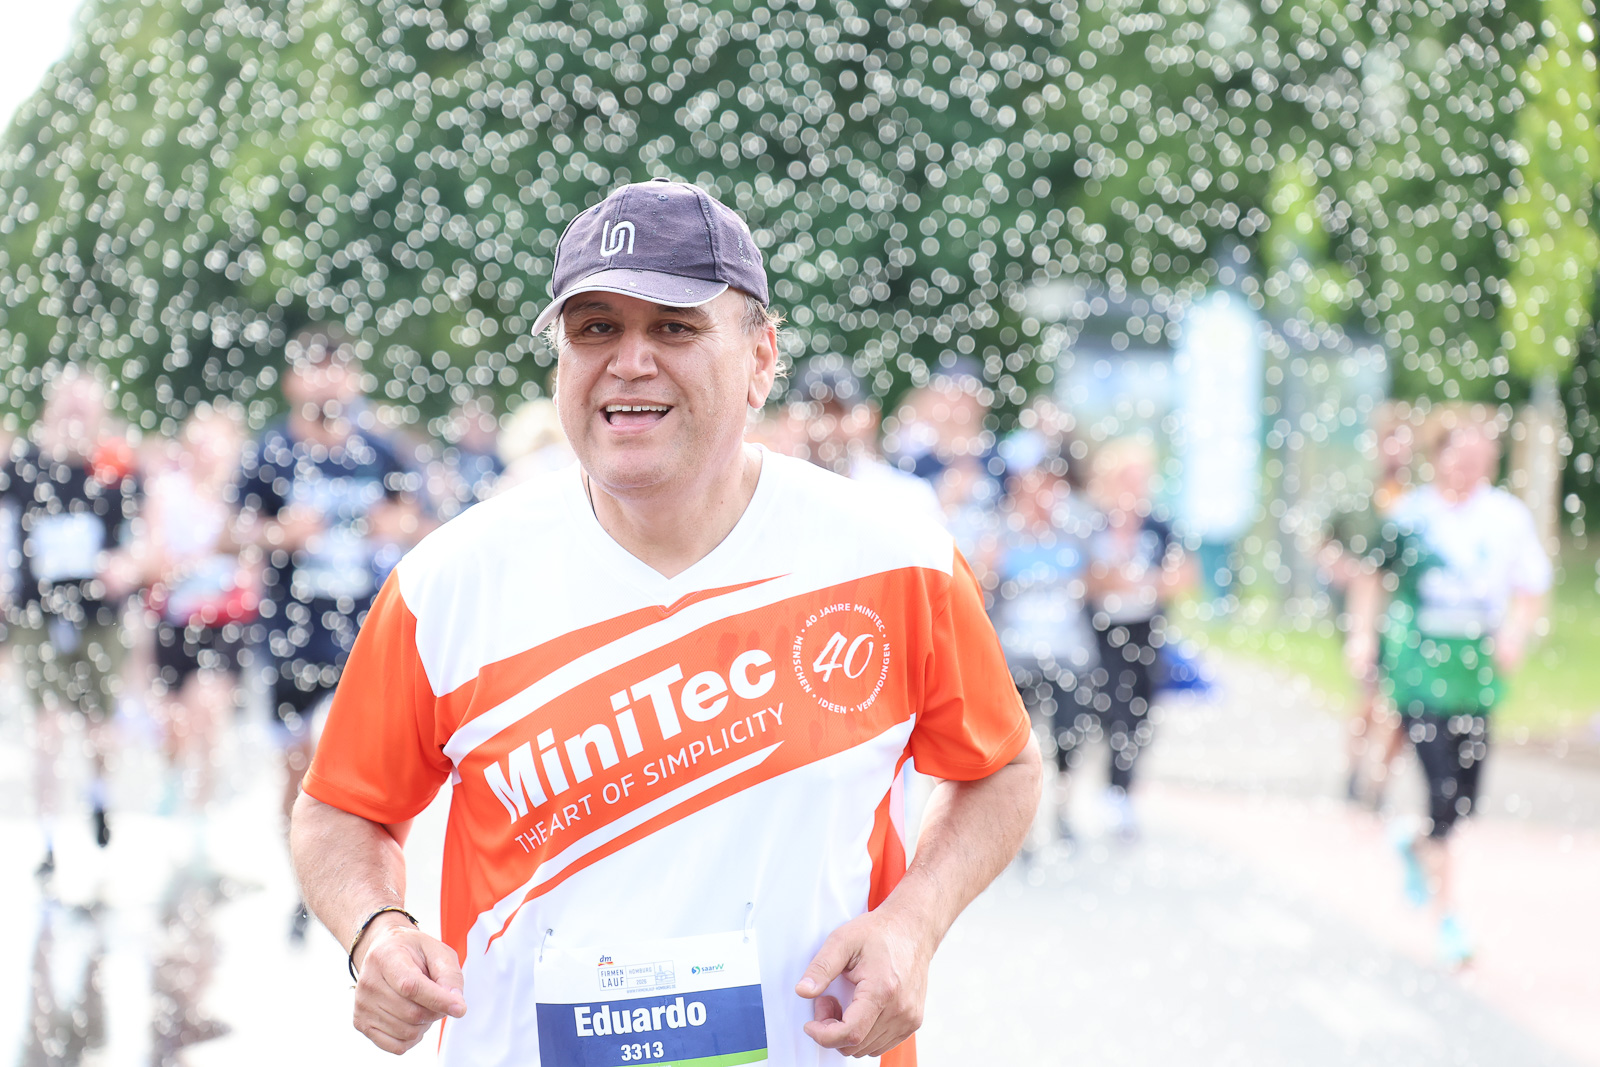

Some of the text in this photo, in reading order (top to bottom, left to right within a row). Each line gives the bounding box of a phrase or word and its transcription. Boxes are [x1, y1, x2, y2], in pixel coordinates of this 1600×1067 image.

[805, 603, 886, 633] 40 JAHRE MINITEC
[792, 635, 813, 693] MENSCHEN
[812, 631, 874, 683] 40
[856, 643, 891, 712] VERBINDUNGEN
[817, 697, 847, 714] IDEEN
[483, 649, 776, 824] MiniTec
[602, 772, 635, 805] OF
[643, 702, 785, 786] SIMPLICITY
[599, 954, 612, 963] dm
[600, 969, 624, 977] FIRMEN
[628, 966, 653, 975] HOMBURG
[601, 976, 624, 988] LAUF
[573, 996, 707, 1037] Eduardo
[620, 1041, 665, 1061] 3313
